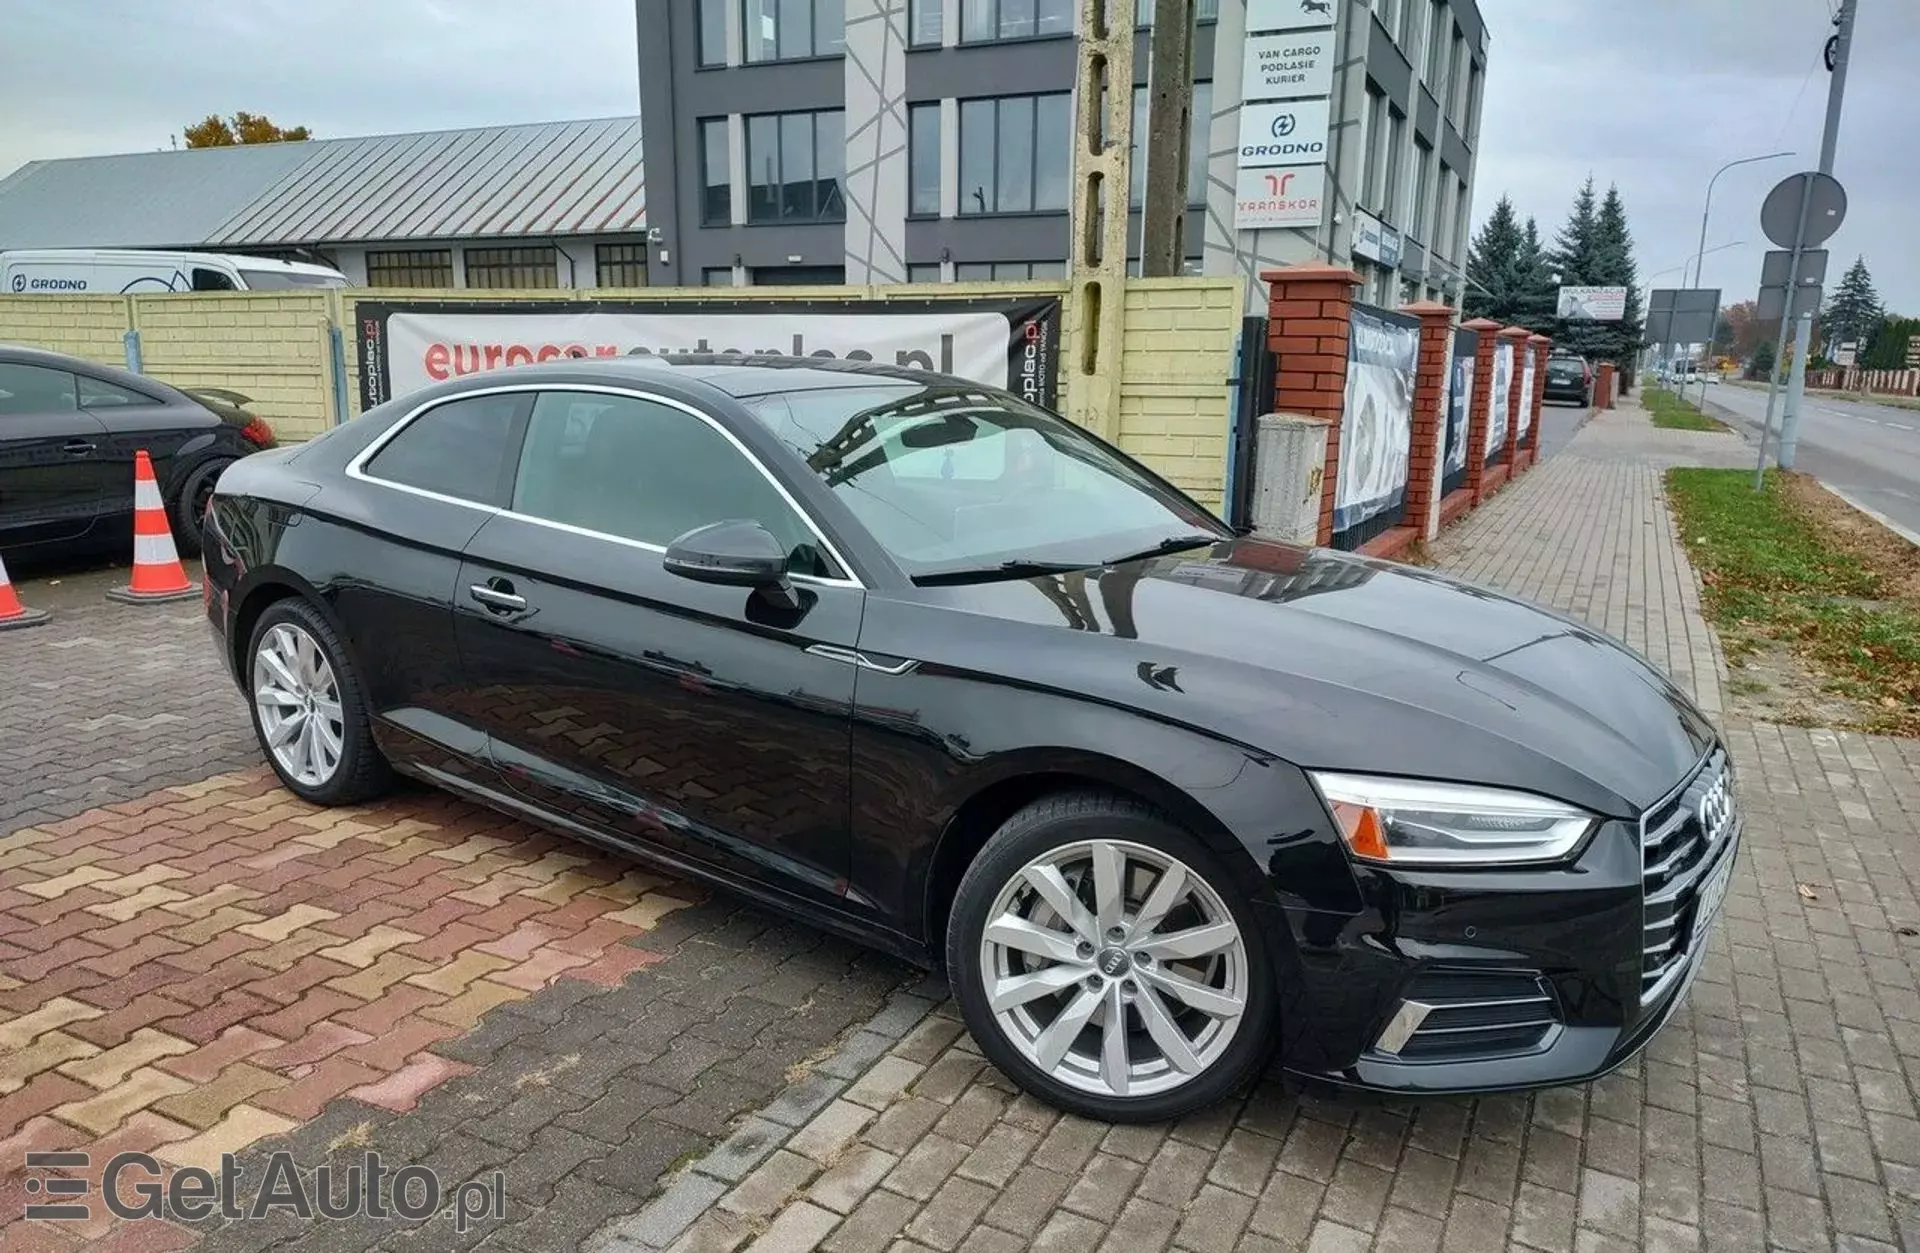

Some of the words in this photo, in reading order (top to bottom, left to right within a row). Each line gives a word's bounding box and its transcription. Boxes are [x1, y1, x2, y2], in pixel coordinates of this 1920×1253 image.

[1258, 50, 1280, 59] VAN
[1282, 46, 1321, 58] CARGO
[1261, 60, 1315, 72] PODLASIE
[1265, 74, 1305, 85] KURIER
[1242, 142, 1323, 156] GRODNO
[31, 278, 87, 291] GRODNO
[364, 319, 378, 408] utoplac.pl
